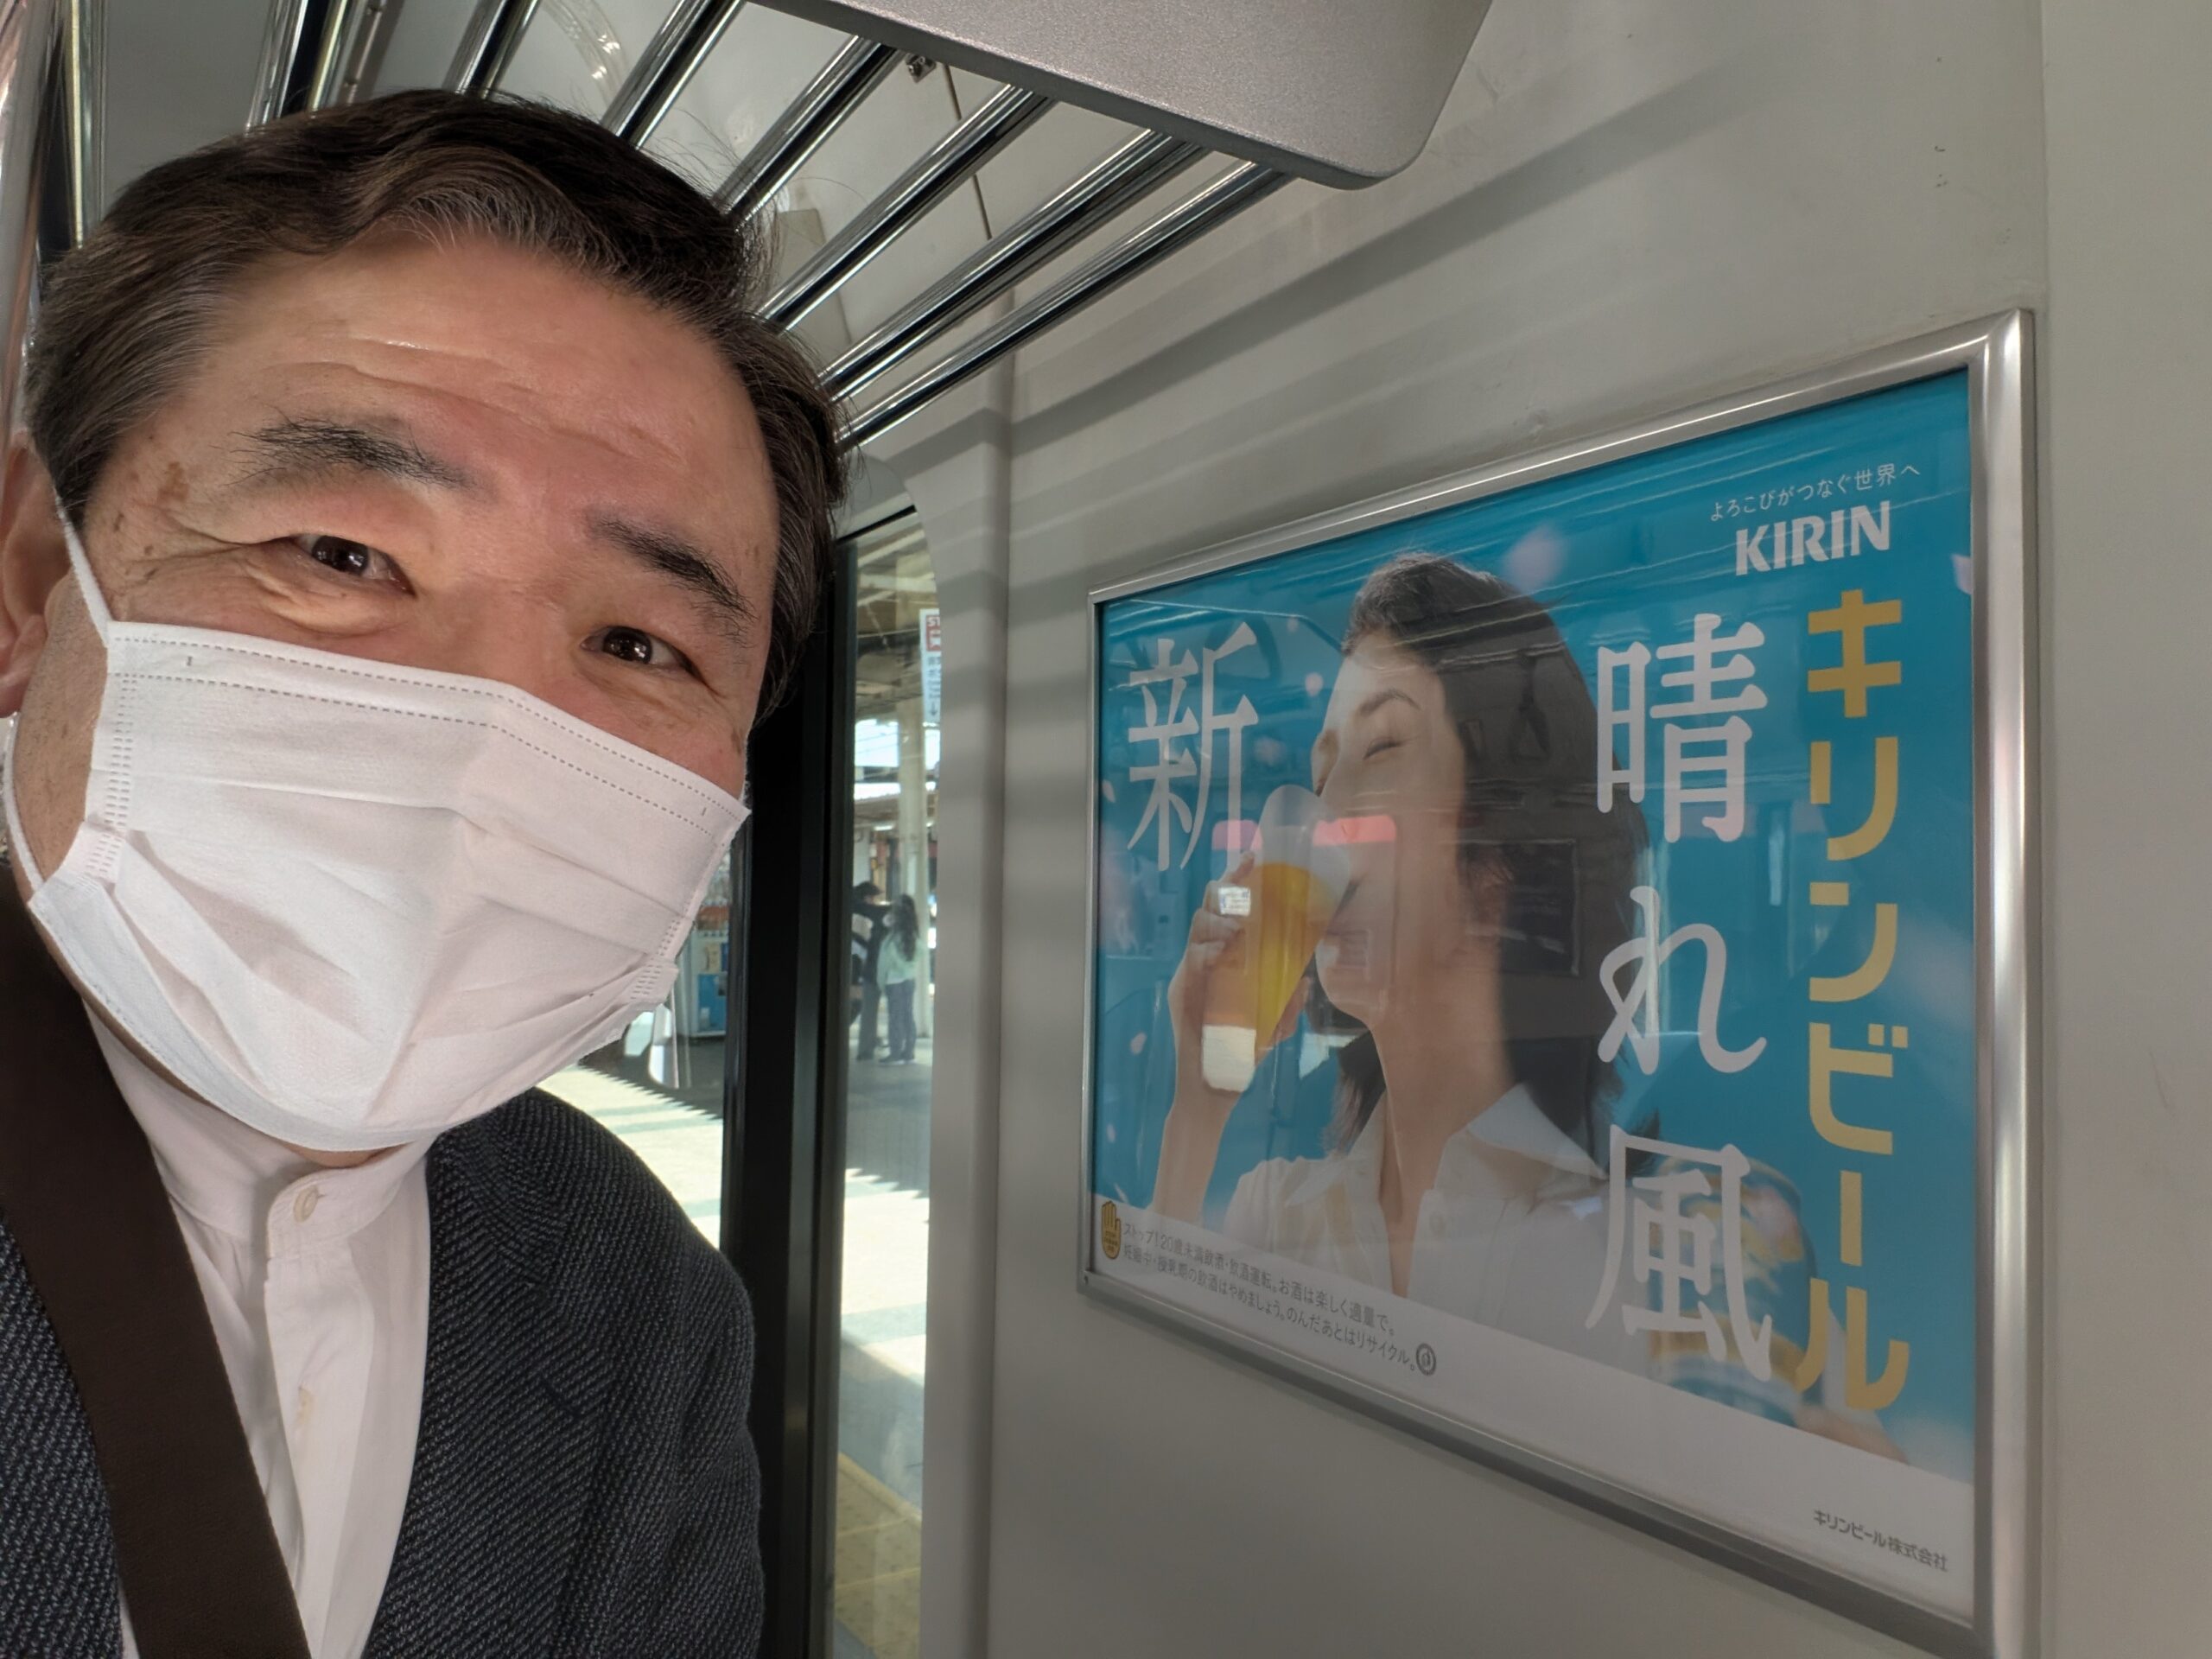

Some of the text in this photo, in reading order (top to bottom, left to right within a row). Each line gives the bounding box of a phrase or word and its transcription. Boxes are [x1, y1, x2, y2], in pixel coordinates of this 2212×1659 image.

[1710, 462, 1921, 522] よろこびがつなぐ世界へ
[1735, 500, 1891, 576] KIRIN
[1127, 621, 1259, 876] 新
[1584, 613, 1772, 1382] 晴れ風
[1795, 588, 1910, 1411] キリンビール
[1813, 1510, 1948, 1572] キリンビール株式会社
